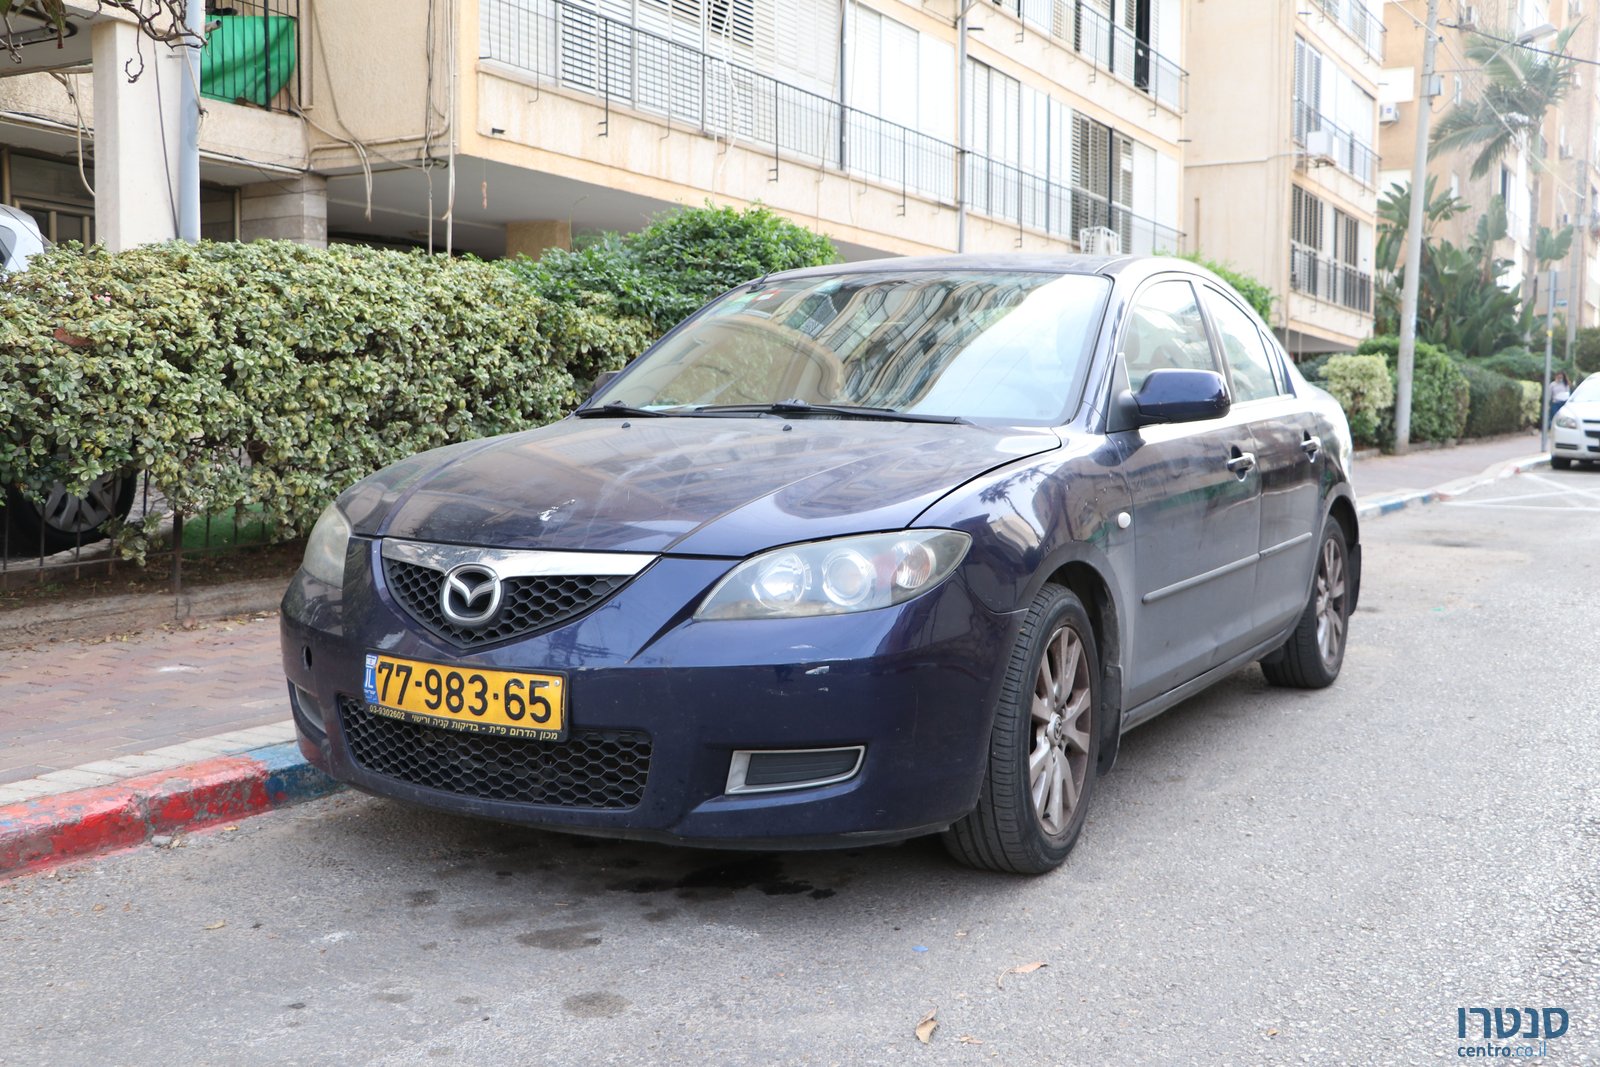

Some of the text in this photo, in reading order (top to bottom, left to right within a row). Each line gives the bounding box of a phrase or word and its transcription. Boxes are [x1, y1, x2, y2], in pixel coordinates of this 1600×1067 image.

[364, 668, 374, 689] IL
[432, 717, 449, 729] קניה
[451, 720, 479, 732] בדיקות
[509, 728, 537, 738] הדרום
[539, 731, 558, 741] מכון
